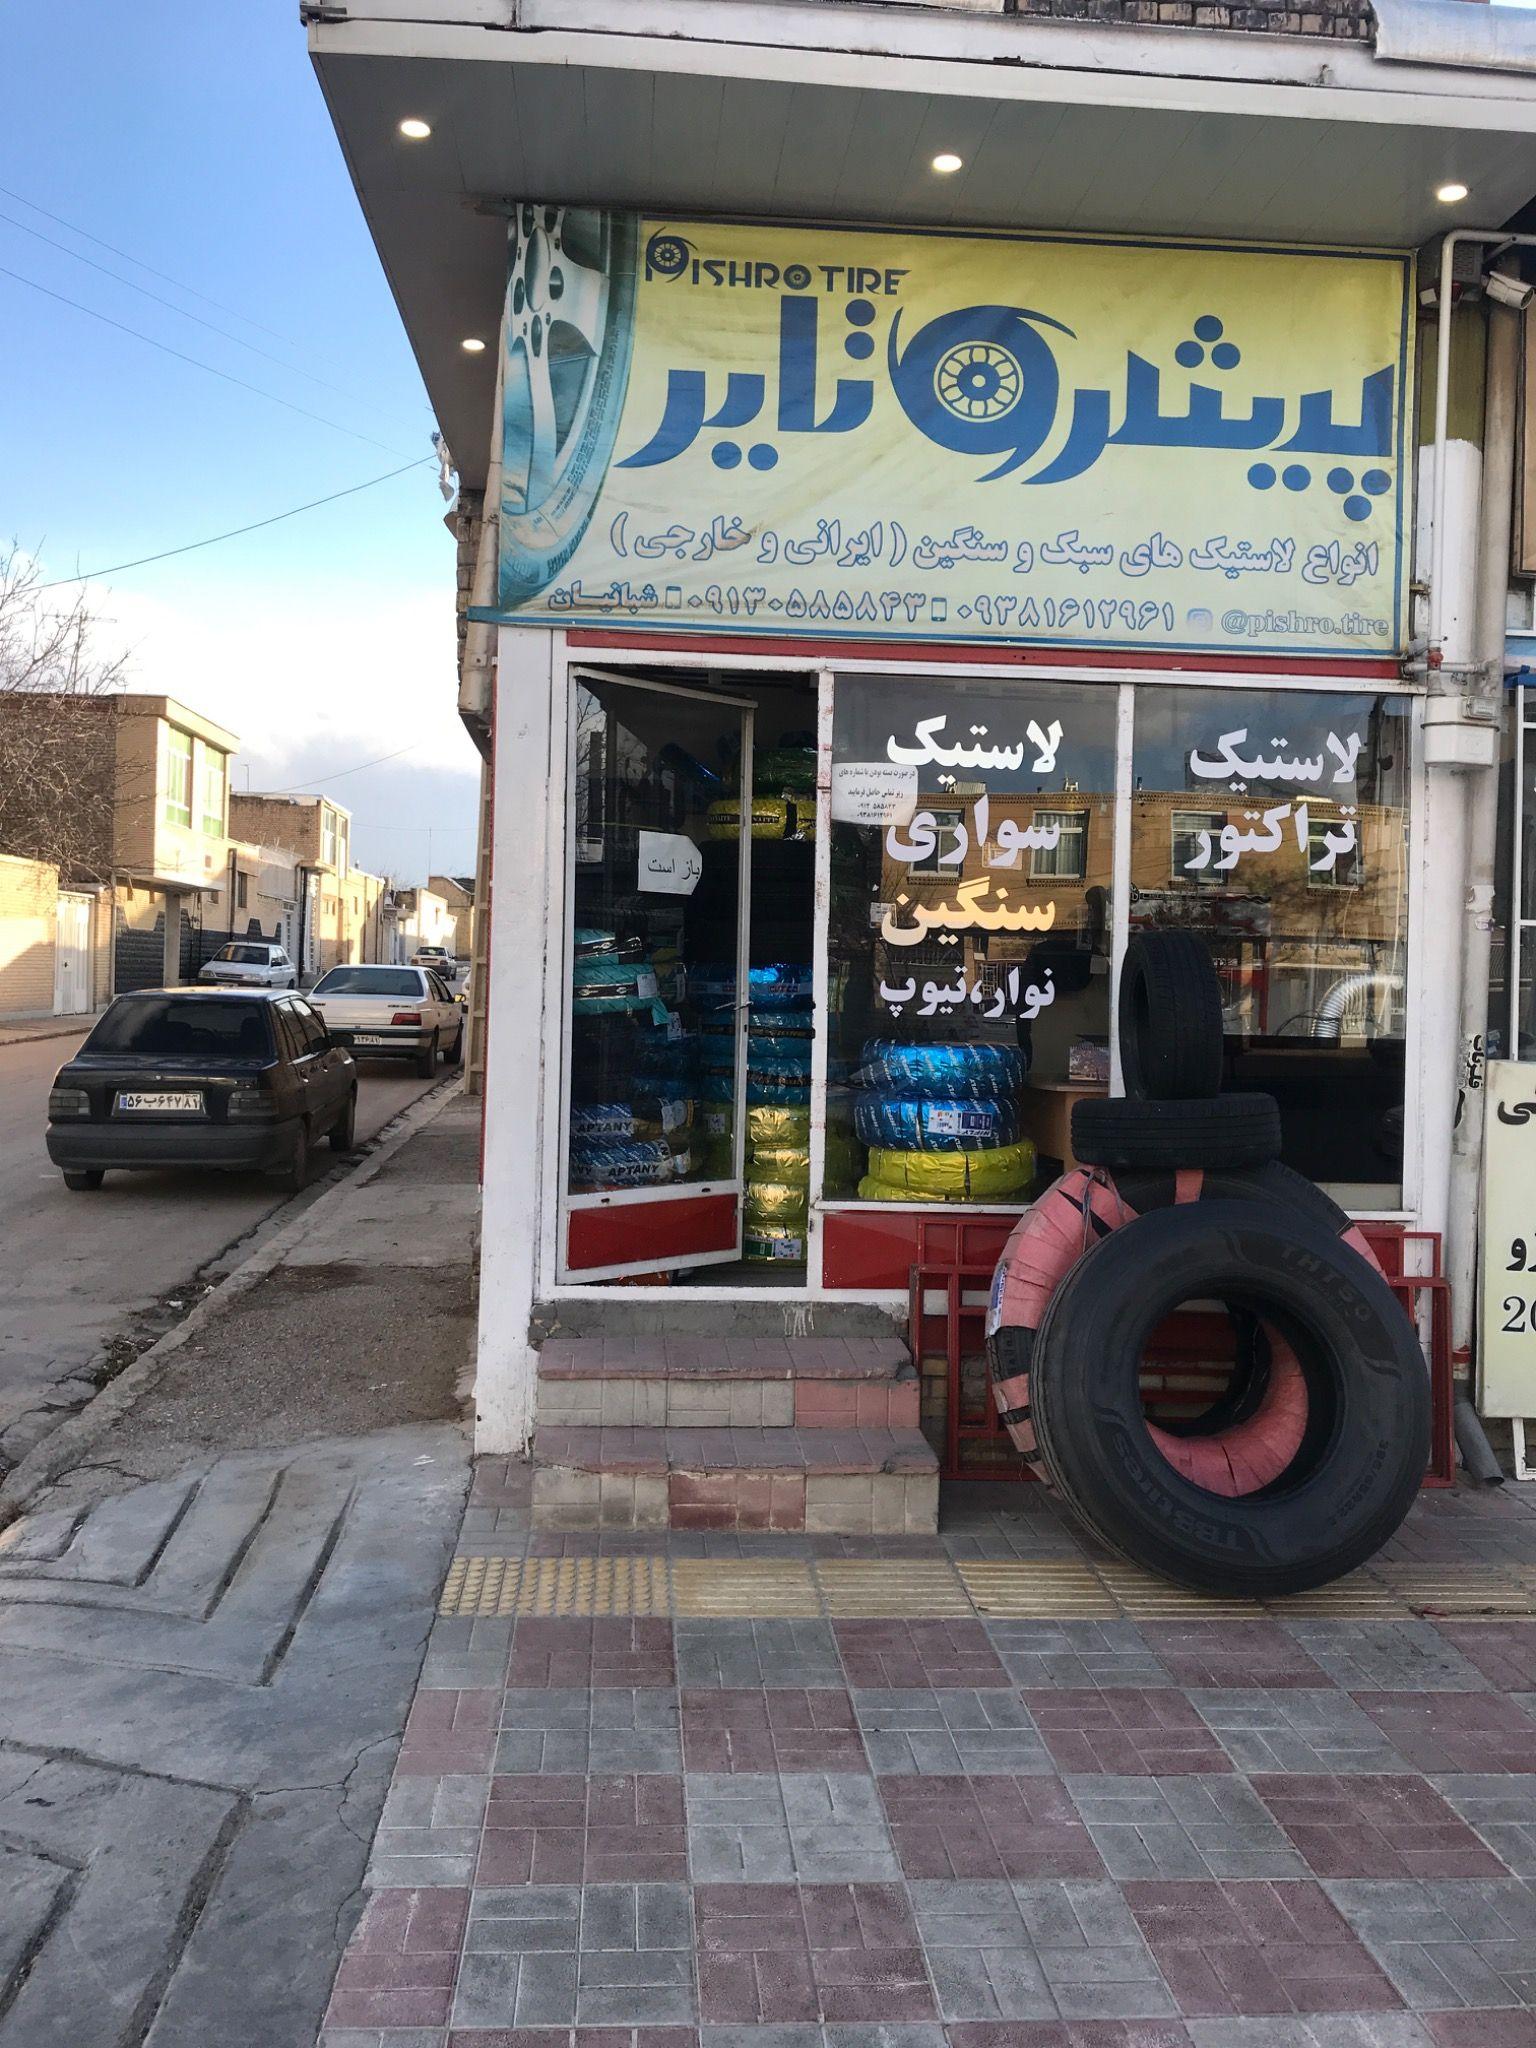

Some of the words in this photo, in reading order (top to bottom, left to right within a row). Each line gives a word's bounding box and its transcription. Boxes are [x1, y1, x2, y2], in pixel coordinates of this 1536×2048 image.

[817, 264, 912, 296] TIRE
[613, 295, 876, 471] تایر
[887, 305, 1395, 521] پیشرو
[756, 531, 779, 564] و
[912, 525, 1009, 570] سنگین
[1012, 541, 1035, 574] و
[1040, 529, 1114, 575] سبک
[1119, 531, 1184, 578] های
[1189, 535, 1296, 580] لاستیک
[1301, 539, 1379, 586] انواع
[687, 585, 927, 623] ۰۹۱۳۰۵۸۵۸۴۳
[957, 594, 1175, 632] ۰۹۳۸۱۶۱۲۹۶۱
[1221, 609, 1390, 637] @pishro.tire
[886, 714, 1064, 787] لاستیک
[1189, 727, 1362, 792] لاستیک
[886, 793, 1061, 866] سواری
[1183, 802, 1357, 871] تراکتور
[647, 858, 675, 874] است
[681, 859, 700, 880] باز
[881, 875, 1057, 946] سنگین
[577, 1121, 632, 1134] APTANY
[608, 1164, 659, 1177] APTANY
